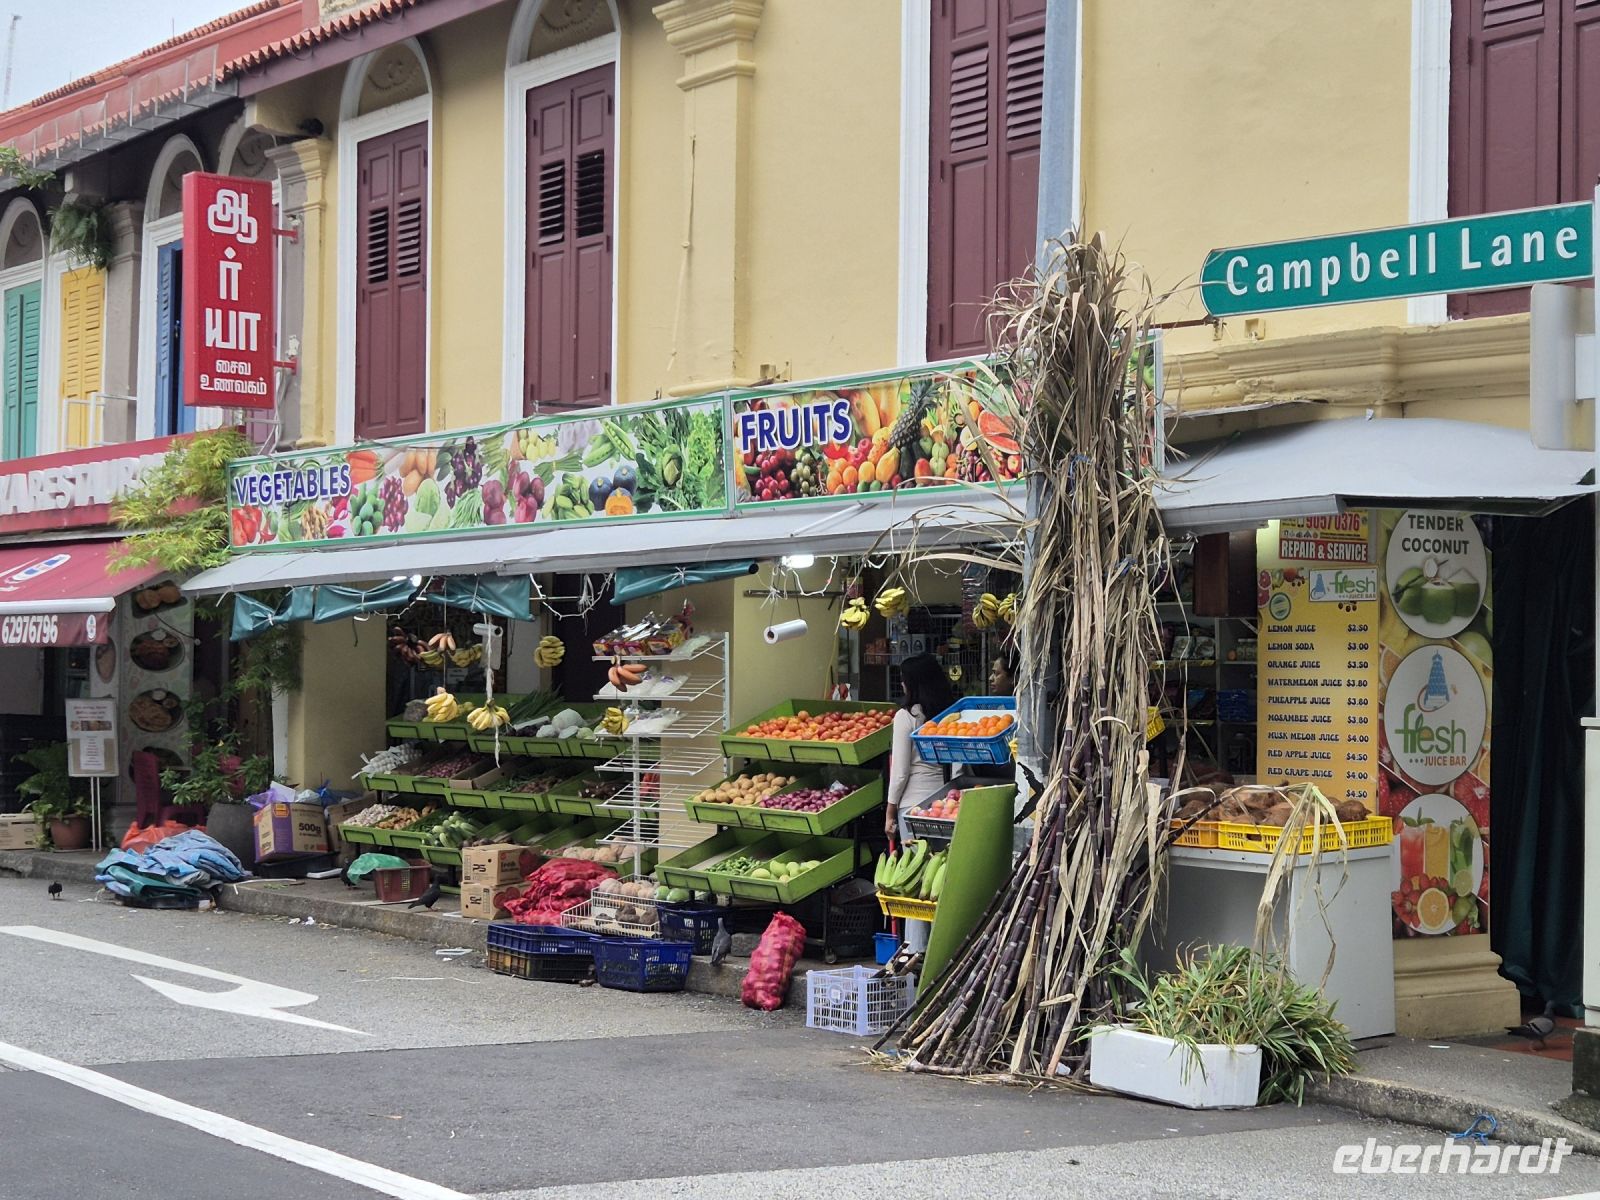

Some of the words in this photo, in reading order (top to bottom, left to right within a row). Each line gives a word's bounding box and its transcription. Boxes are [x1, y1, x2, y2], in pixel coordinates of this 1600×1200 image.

[1226, 231, 1437, 296] Campbell
[1461, 225, 1578, 270] Lane
[200, 375, 267, 395] உணவகம்
[740, 398, 852, 453] FRUITS
[234, 463, 351, 506] VEGETABLES
[1335, 512, 1361, 531] 0376
[1408, 514, 1464, 532] TENDER
[1281, 540, 1316, 559] REPAIR
[1318, 544, 1325, 559] &
[1327, 542, 1367, 561] SERVICE
[1402, 537, 1470, 555] COCONUT
[1329, 571, 1376, 594] fresh
[2, 615, 58, 643] 62976796
[1347, 624, 1369, 632] $2.50
[1347, 642, 1369, 650] $3.00
[1347, 661, 1369, 669] $3.50
[1267, 679, 1318, 687] WATERMELON
[1321, 679, 1342, 687] JUICE
[1346, 679, 1368, 687] $3.80
[1267, 696, 1307, 704] PINEAPPLE
[1310, 697, 1331, 705] JUICE
[1267, 714, 1308, 723] MOSAMBEE
[1310, 715, 1332, 723] JUICE
[1347, 715, 1369, 724] $3.80
[1395, 703, 1466, 754] fresh
[1267, 732, 1288, 740] MUSK
[1290, 733, 1316, 741] MELON
[1318, 734, 1340, 742] JUICE
[1347, 734, 1369, 742] $4.00
[1285, 750, 1308, 758] APPLE
[1346, 753, 1368, 761] $4.50
[1424, 756, 1448, 766] JUICE
[1450, 756, 1467, 766] BAR
[1285, 768, 1309, 776] GRAPE
[1312, 770, 1333, 778] JUICE
[1346, 771, 1368, 779] $4.00
[1346, 789, 1368, 798] $4.50
